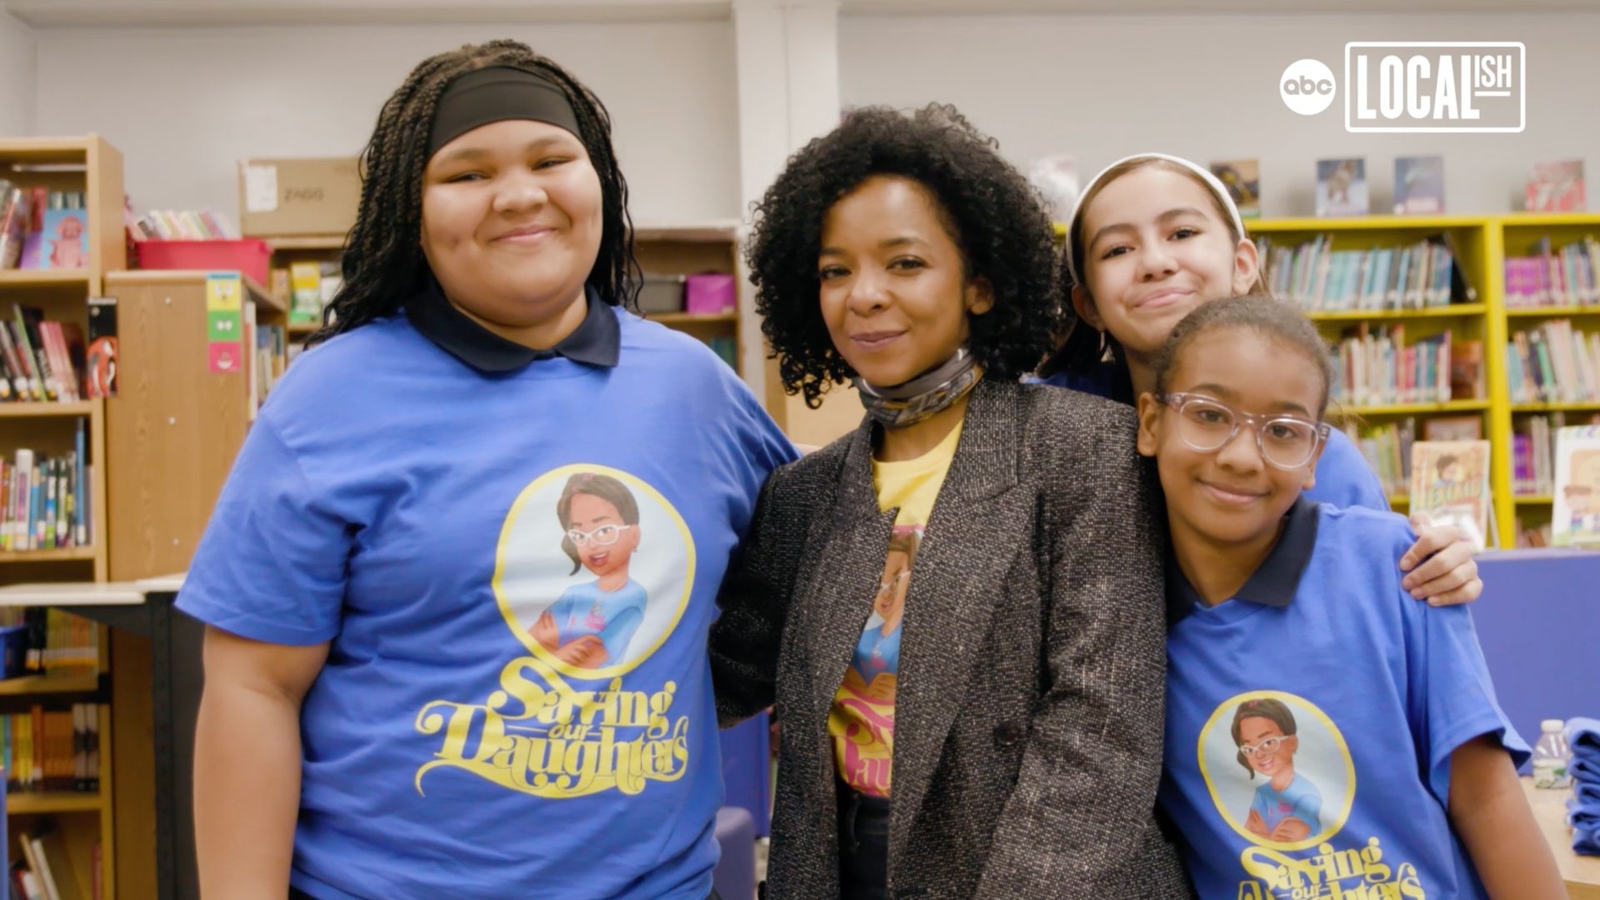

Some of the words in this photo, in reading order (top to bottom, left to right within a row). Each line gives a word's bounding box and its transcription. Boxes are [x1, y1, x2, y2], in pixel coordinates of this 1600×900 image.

[487, 656, 677, 739] Saving
[415, 699, 689, 799] Daughters
[548, 724, 594, 741] our
[1240, 836, 1391, 890] Saving
